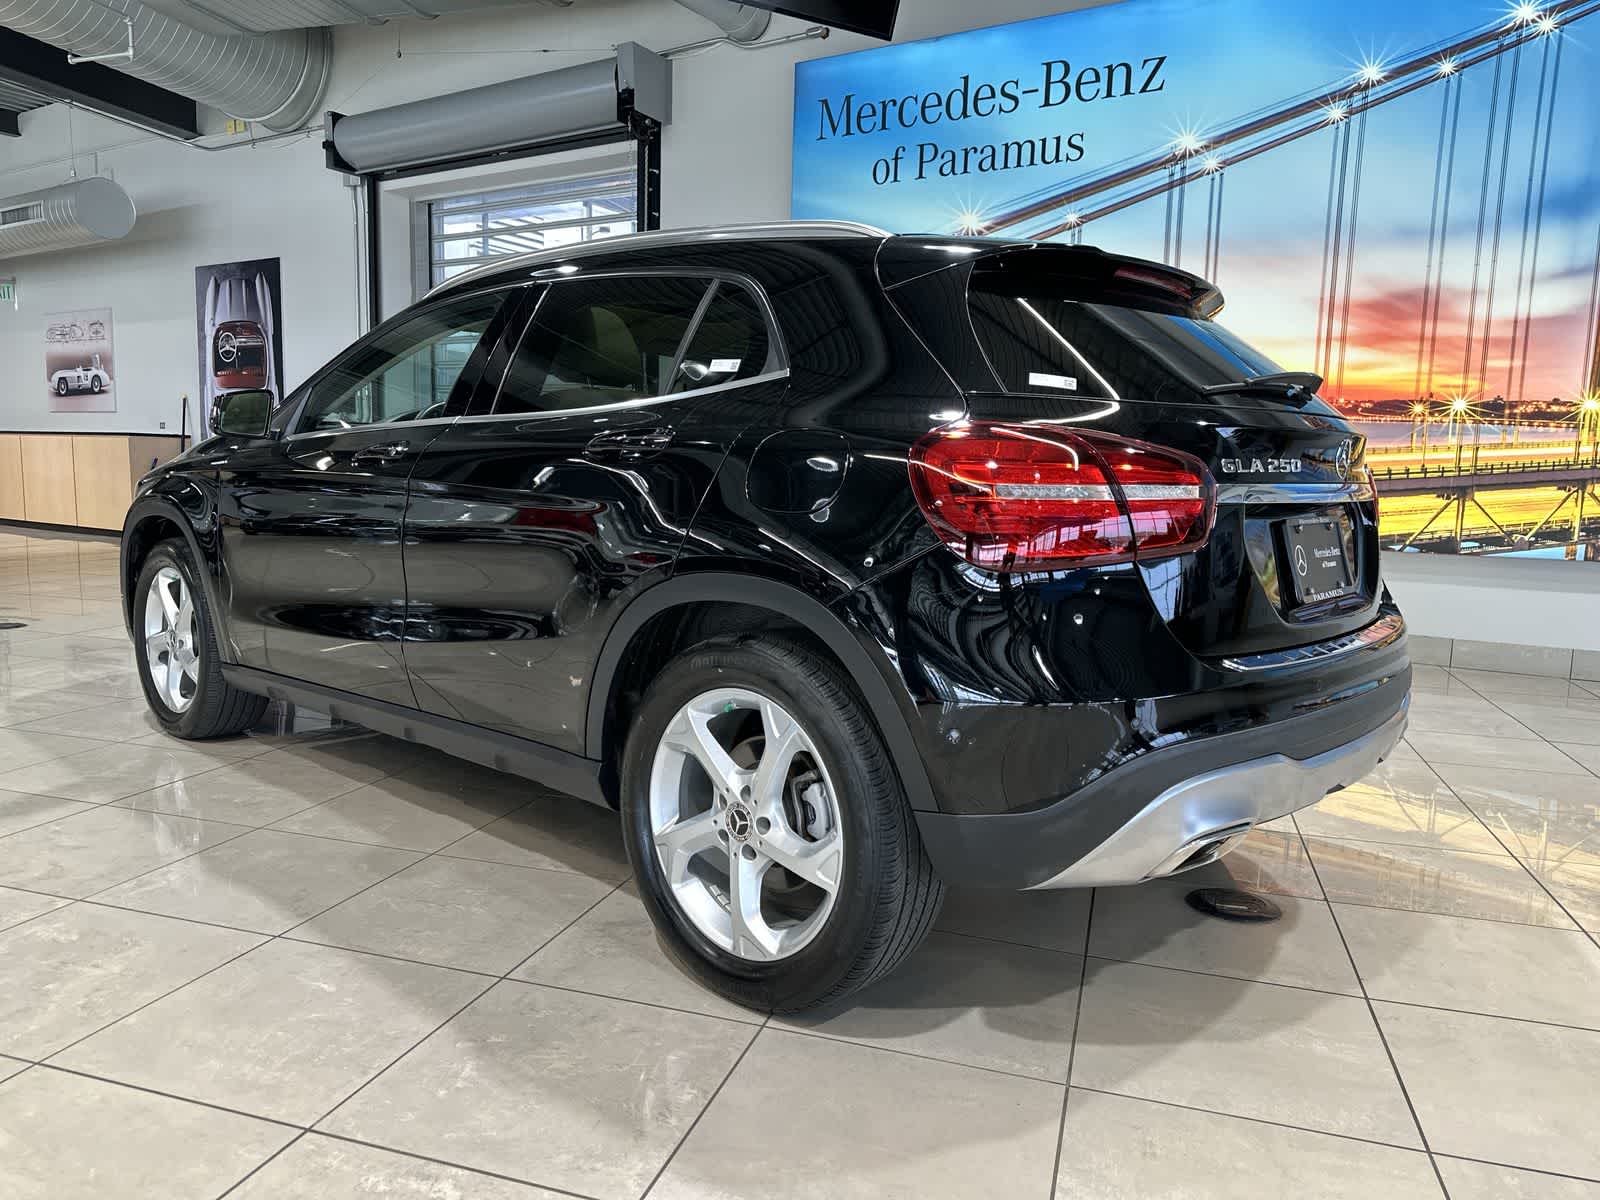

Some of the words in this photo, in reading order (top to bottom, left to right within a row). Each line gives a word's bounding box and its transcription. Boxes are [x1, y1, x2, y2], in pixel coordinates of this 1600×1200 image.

[815, 55, 1168, 142] Mercedes-Benz
[871, 145, 906, 186] of
[914, 131, 1086, 181] Paramus
[1220, 458, 1265, 473] GLA
[1267, 458, 1302, 473] 250
[1312, 588, 1344, 601] PARAMUS
